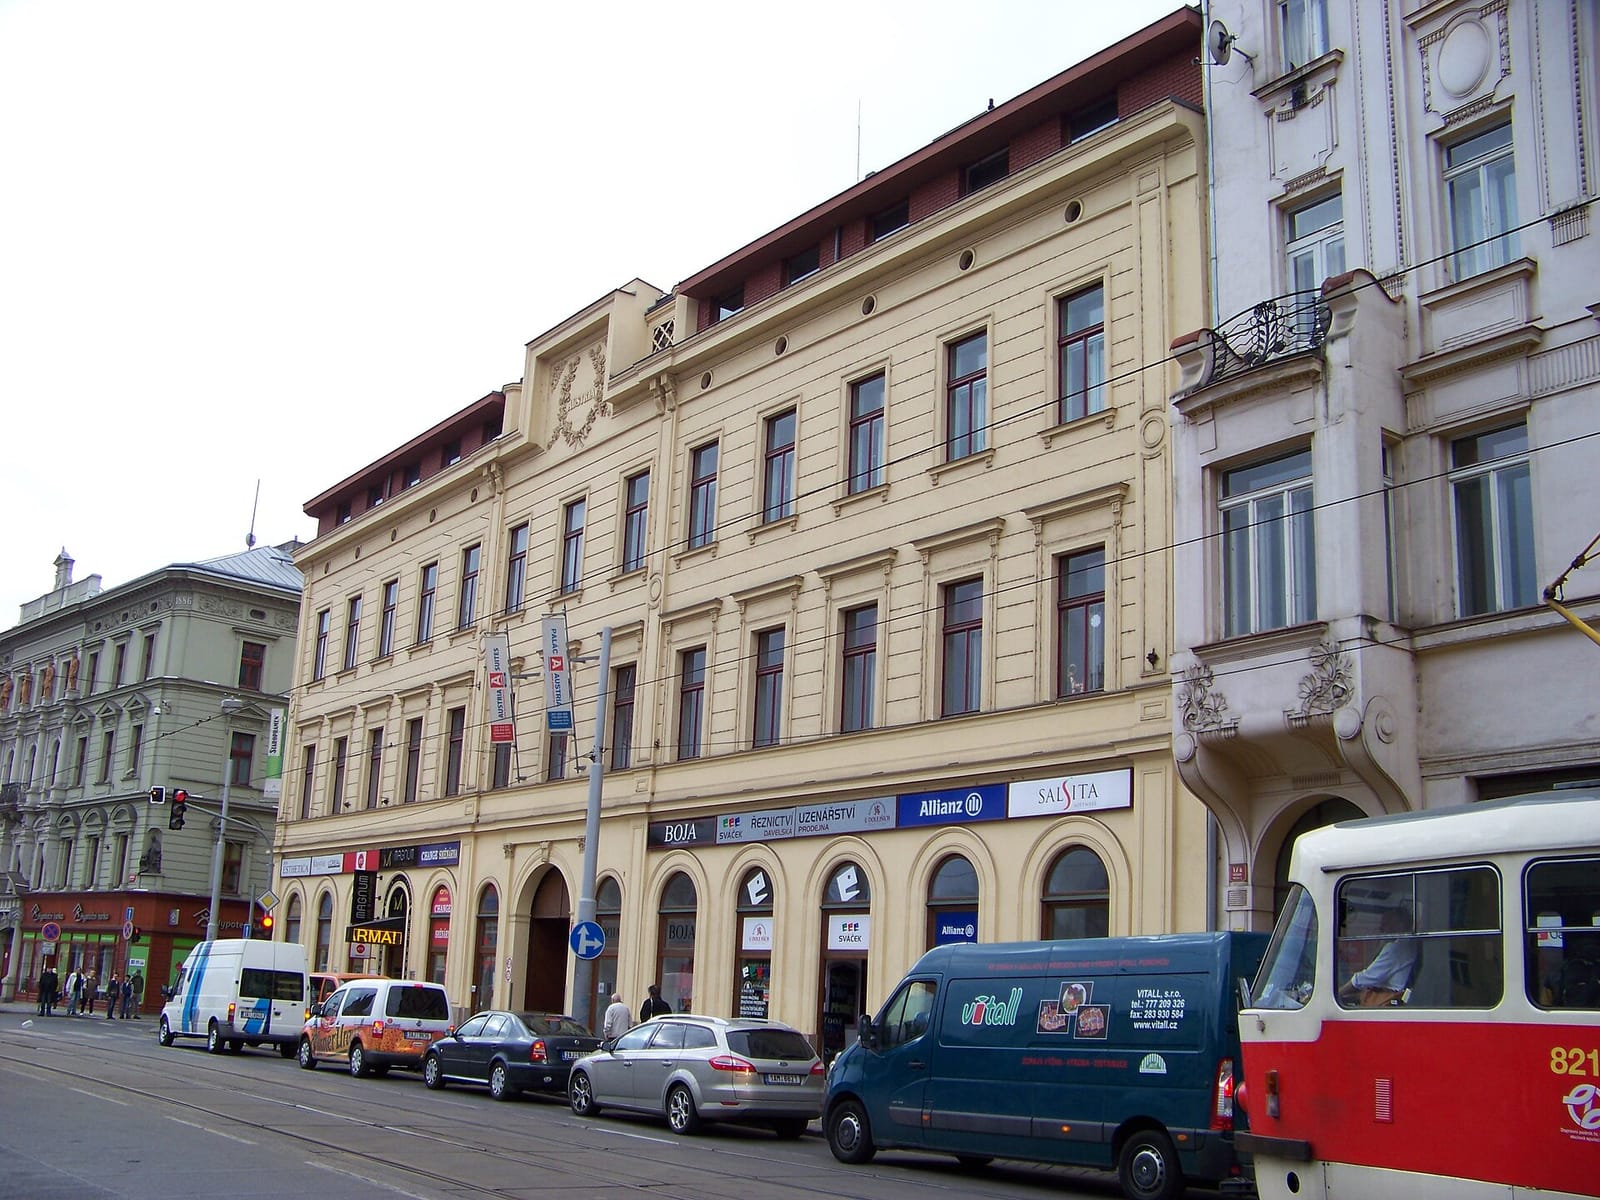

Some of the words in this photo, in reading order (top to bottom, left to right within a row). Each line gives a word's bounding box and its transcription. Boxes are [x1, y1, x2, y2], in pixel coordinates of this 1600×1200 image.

[553, 673, 562, 707] AUSTRIA
[496, 689, 504, 719] AUSTRIA
[1038, 778, 1099, 811] SALSITA
[751, 811, 794, 829] ŘEZNICTVÍ
[799, 804, 857, 824] UZENÁŘSTVÍ
[920, 799, 963, 817] Allianz
[664, 823, 697, 843] BOJA
[798, 823, 830, 833] PRODEJNA
[356, 875, 369, 919] MAGNUM
[668, 924, 696, 940] BOJA
[941, 926, 964, 936] Allianz
[1164, 990, 1181, 998] s.r.o.
[1131, 1000, 1144, 1009] tel.:
[1145, 999, 1158, 1008] 777
[1159, 999, 1171, 1008] 209
[1172, 999, 1185, 1008] 326
[1130, 1010, 1143, 1018] fax:
[1144, 1010, 1157, 1018] 283
[1157, 1010, 1170, 1018] 930
[1171, 1010, 1184, 1018] 584
[1133, 1020, 1178, 1029] www.vitall.cz
